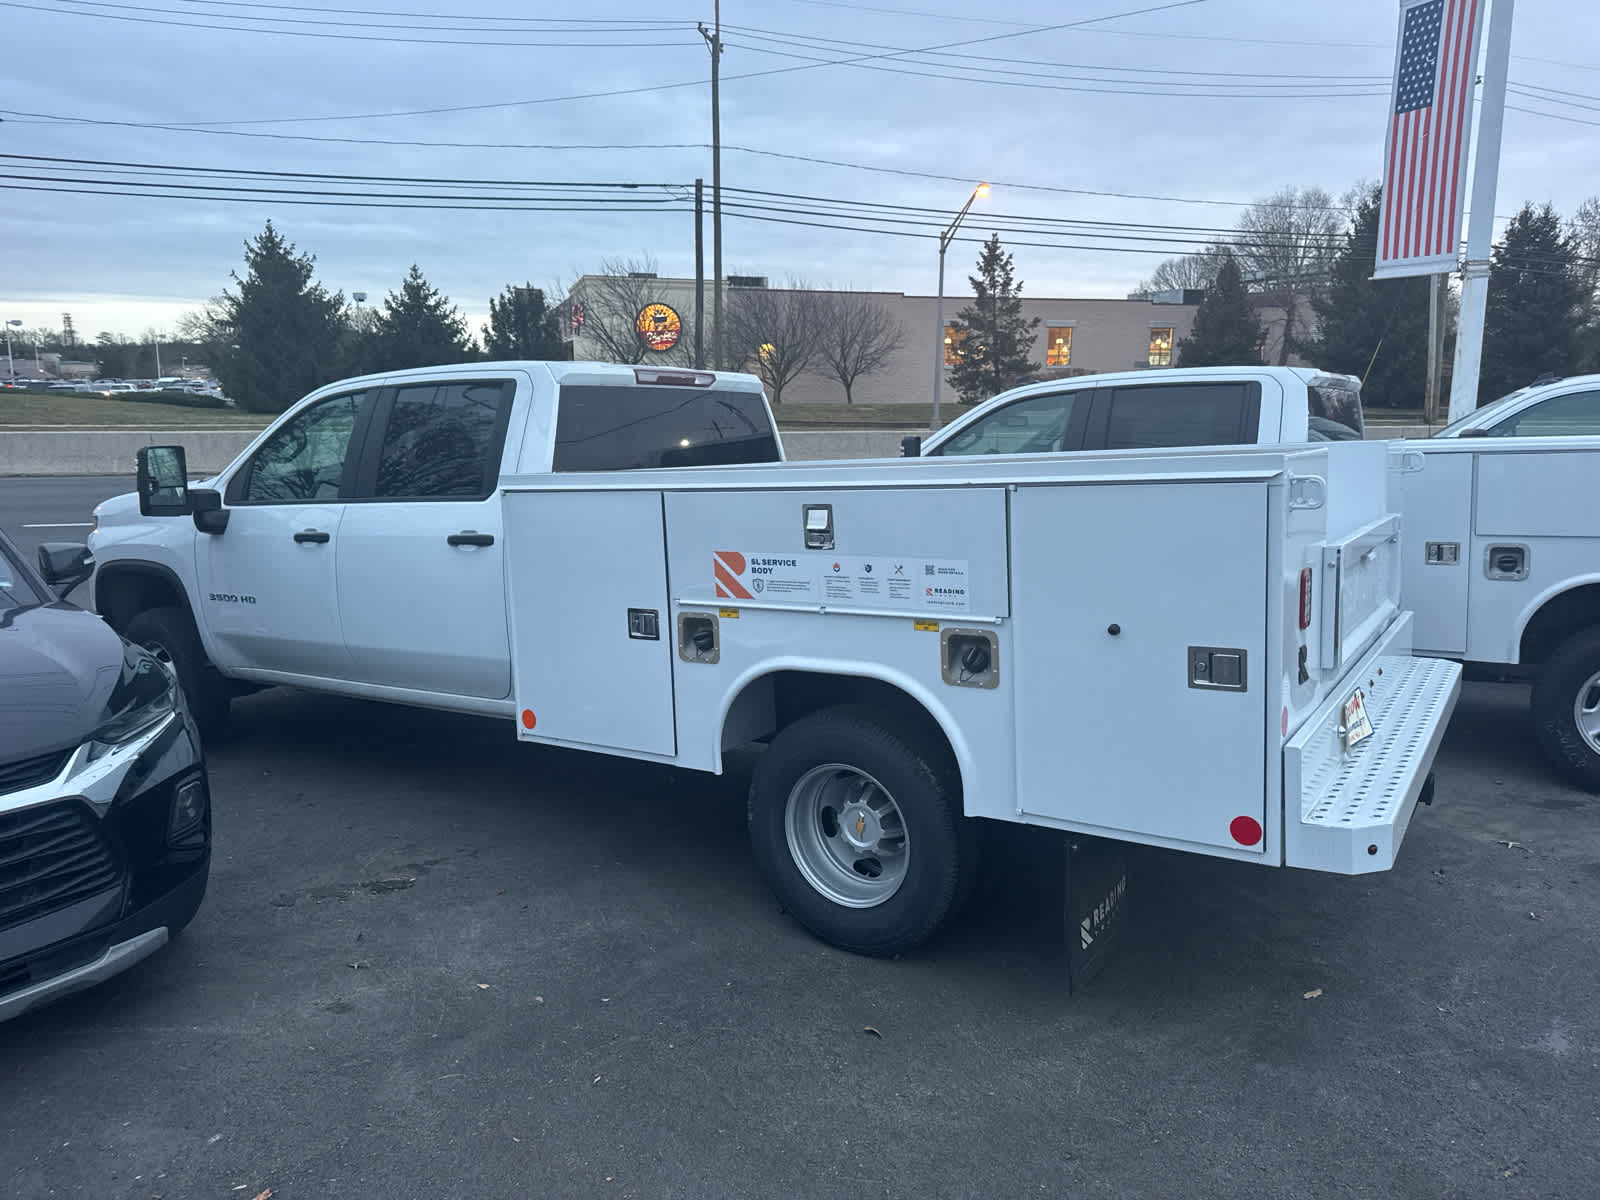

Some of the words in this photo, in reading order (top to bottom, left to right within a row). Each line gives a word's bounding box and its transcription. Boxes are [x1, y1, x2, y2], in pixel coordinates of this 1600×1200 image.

[751, 558, 761, 566] SL
[762, 559, 797, 567] SERVICE
[751, 567, 773, 575] BODY
[208, 593, 238, 602] 3500
[240, 595, 256, 604] HD
